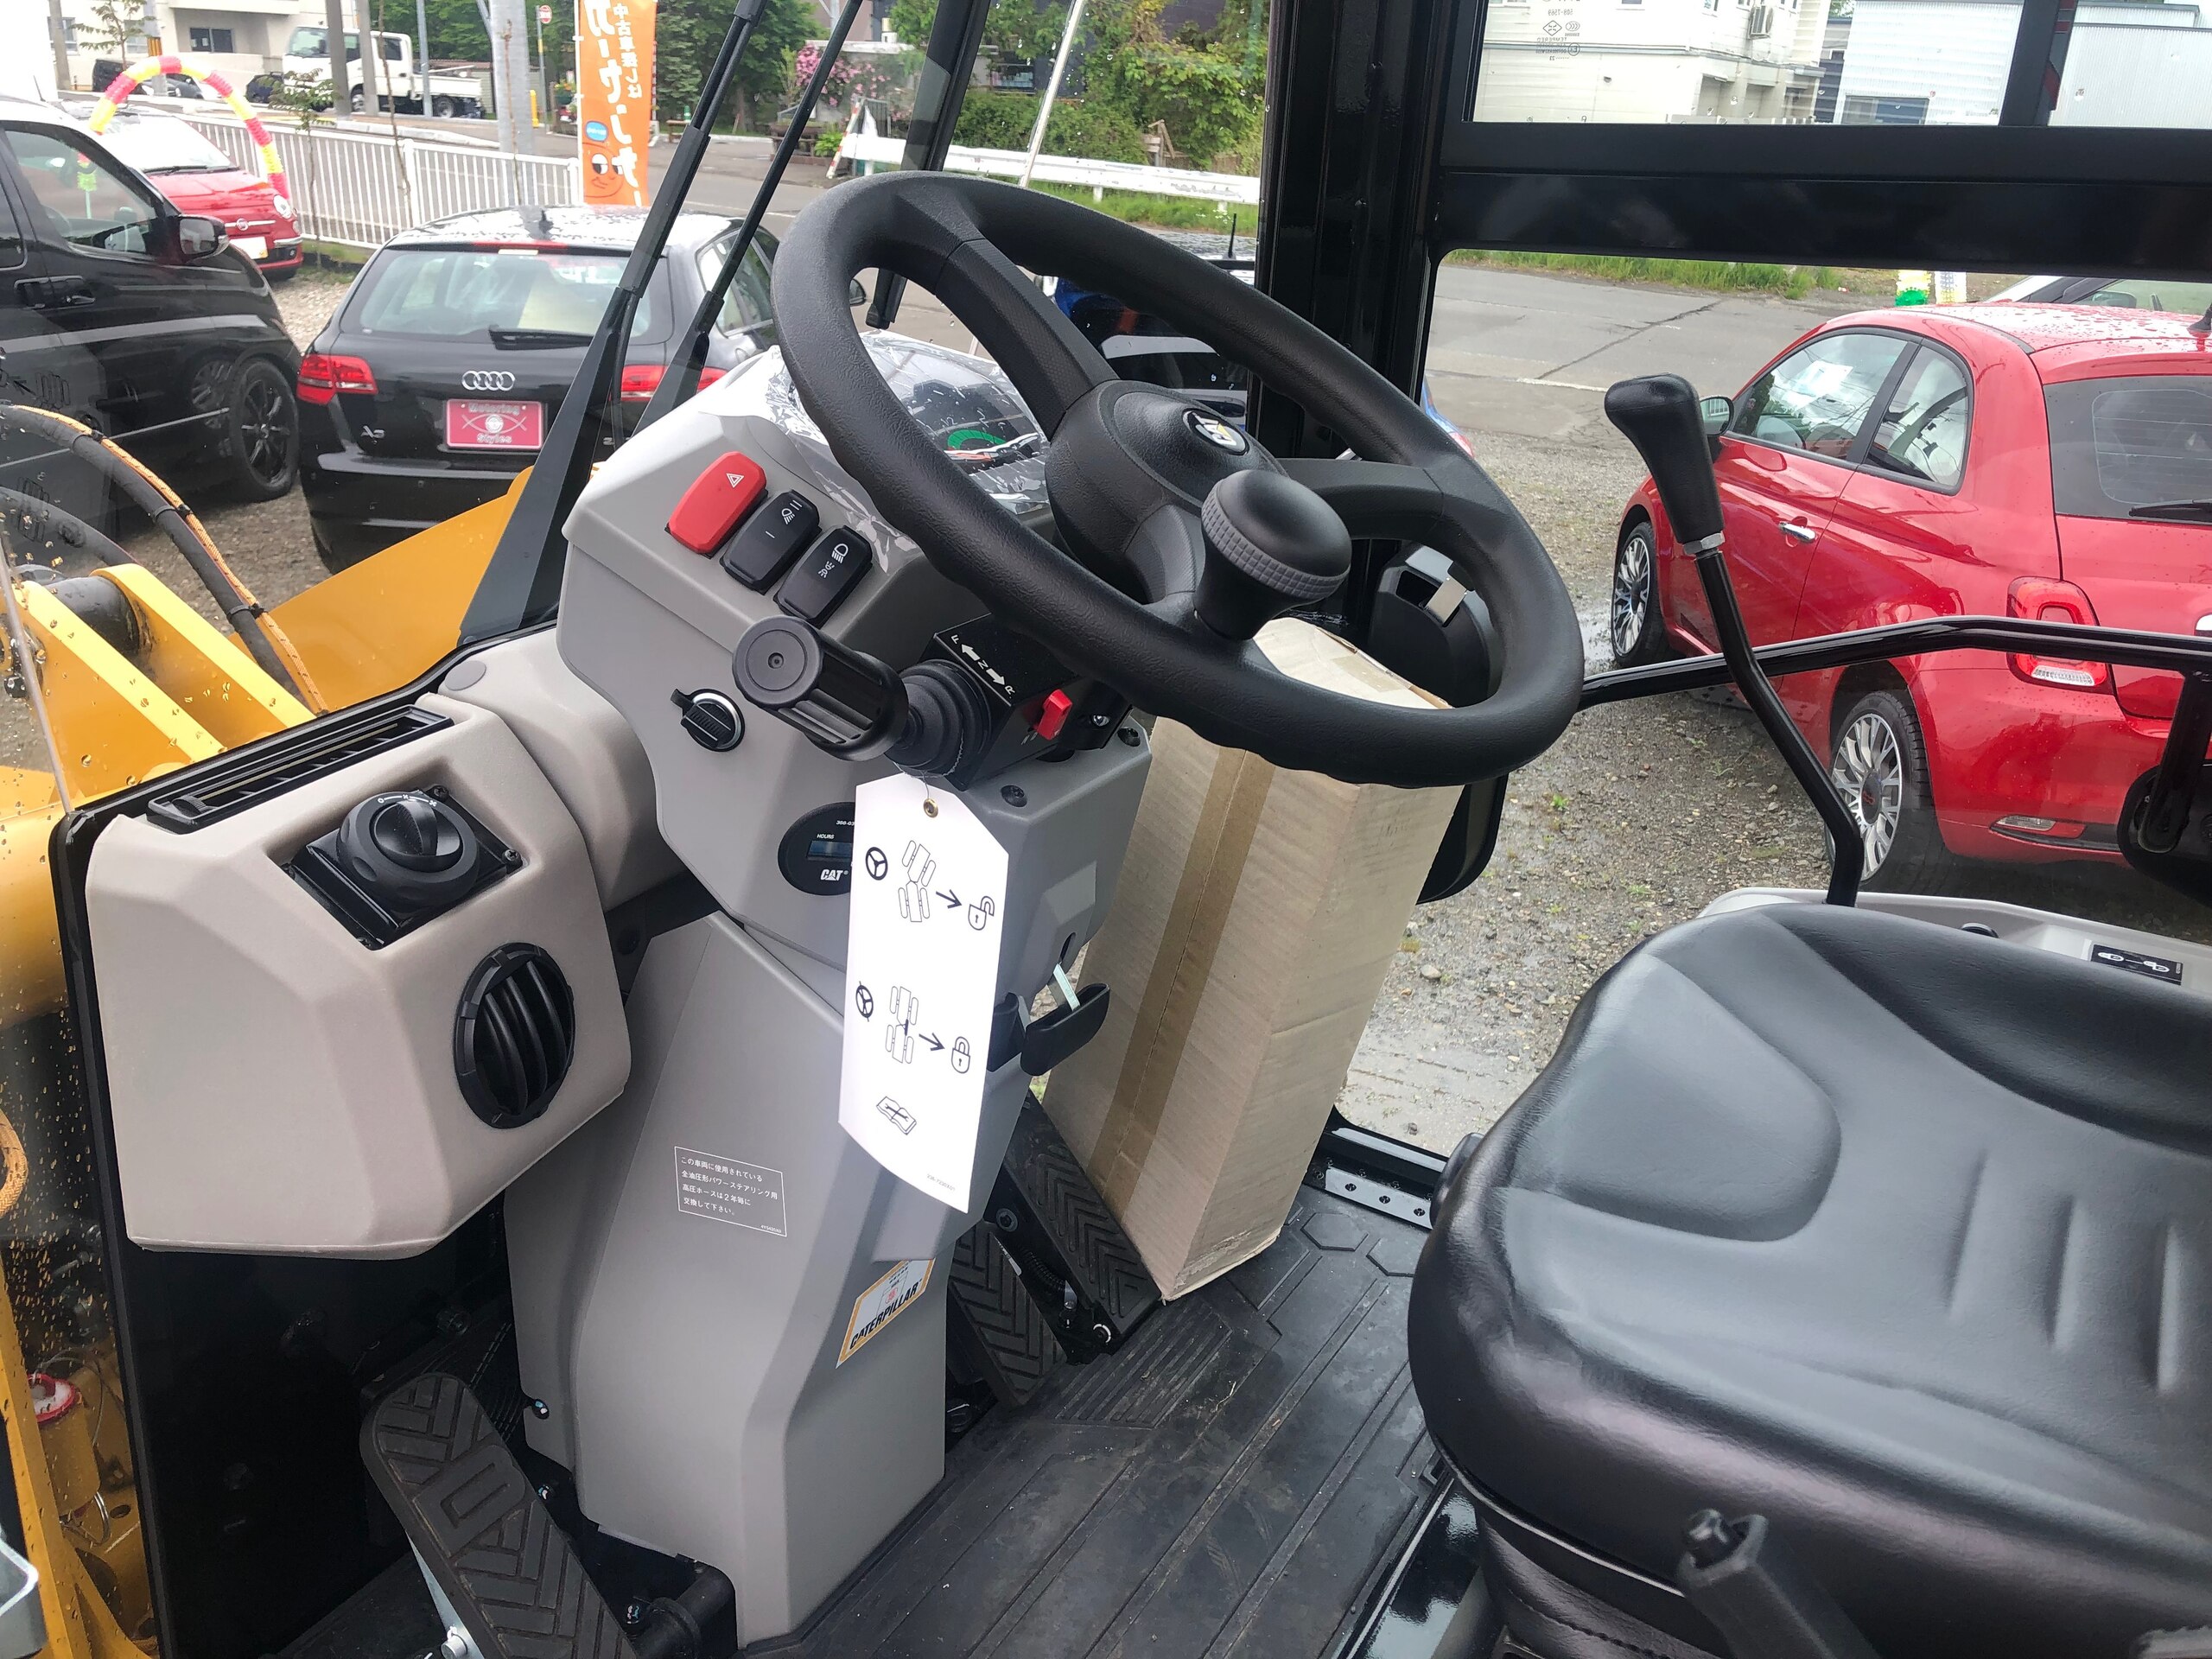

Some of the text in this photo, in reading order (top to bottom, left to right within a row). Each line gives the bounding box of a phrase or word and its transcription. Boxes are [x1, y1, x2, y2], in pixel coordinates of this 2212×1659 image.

[681, 1156, 763, 1182] この車両に使用されている
[681, 1169, 779, 1200] 全油圧形パワーステアリング用
[683, 1197, 735, 1216] 交換して下さい。
[849, 1281, 919, 1350] CATERPILLAR
